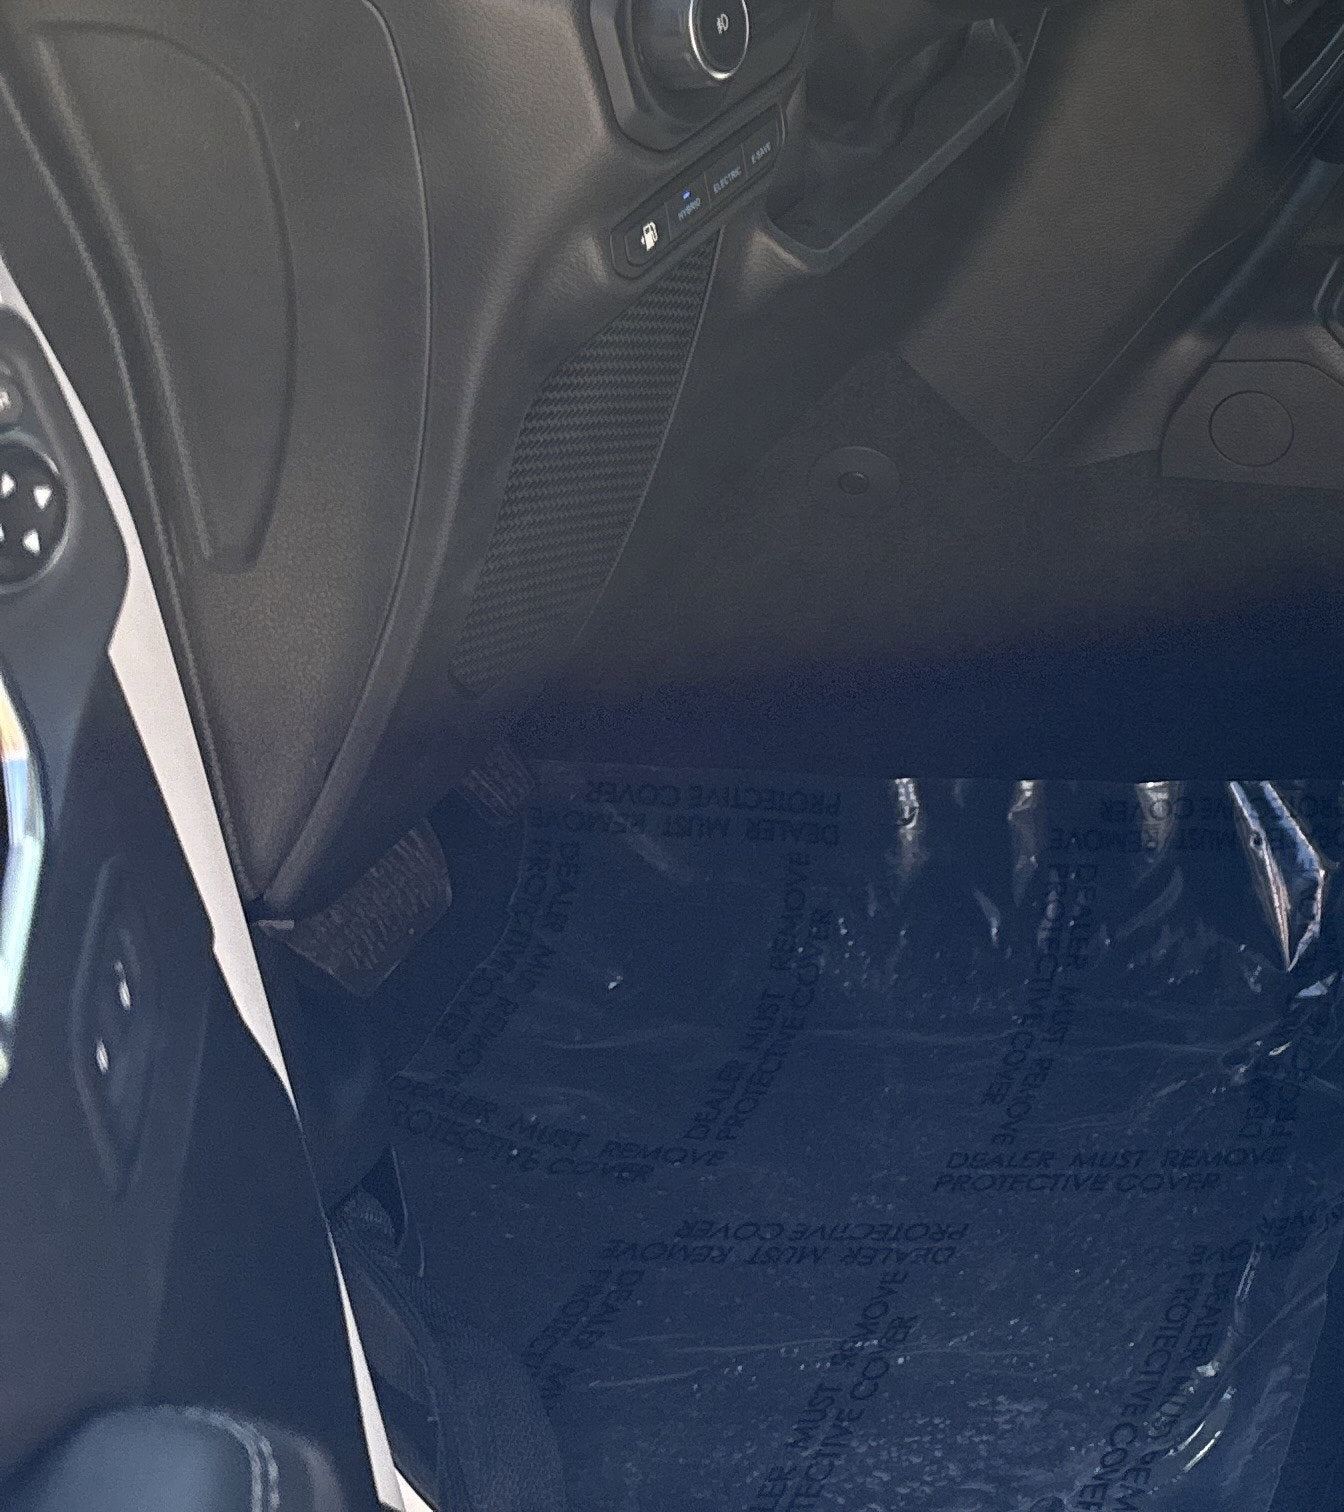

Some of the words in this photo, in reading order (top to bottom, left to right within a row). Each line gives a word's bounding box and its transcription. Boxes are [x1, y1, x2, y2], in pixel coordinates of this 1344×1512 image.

[584, 779, 682, 807] COVER
[687, 784, 841, 817] PROTECTIVE
[661, 814, 732, 838] MUST
[744, 817, 840, 846] DEALER
[683, 1058, 748, 1141] DEALER
[737, 987, 784, 1053] MUST
[768, 852, 810, 973] REMOVE
[715, 1013, 806, 1141] PROTECTIVE
[791, 907, 833, 1011] COVER
[1045, 985, 1085, 1047] MUST
[980, 1029, 1035, 1108] COVER
[991, 1056, 1055, 1147] REMOVE
[508, 1114, 589, 1152] MUST
[599, 1139, 729, 1169] REMOVE
[945, 1149, 1056, 1171] DEALER
[1068, 1149, 1148, 1170] MUST
[1159, 1144, 1289, 1170] REMOVE
[547, 1148, 655, 1184] COVER
[932, 1170, 1110, 1192] PROTECTIVE
[1112, 1170, 1222, 1192] COVER
[674, 1219, 785, 1242] COVER
[787, 1221, 970, 1243] PROTECTIVE
[601, 1239, 735, 1265] REMOVE
[742, 1243, 831, 1266] MUST
[839, 1245, 958, 1266] DEALER
[1180, 1267, 1239, 1363] DEALER
[1121, 1272, 1205, 1418] PROTECTIVE
[785, 1382, 843, 1450] MUST
